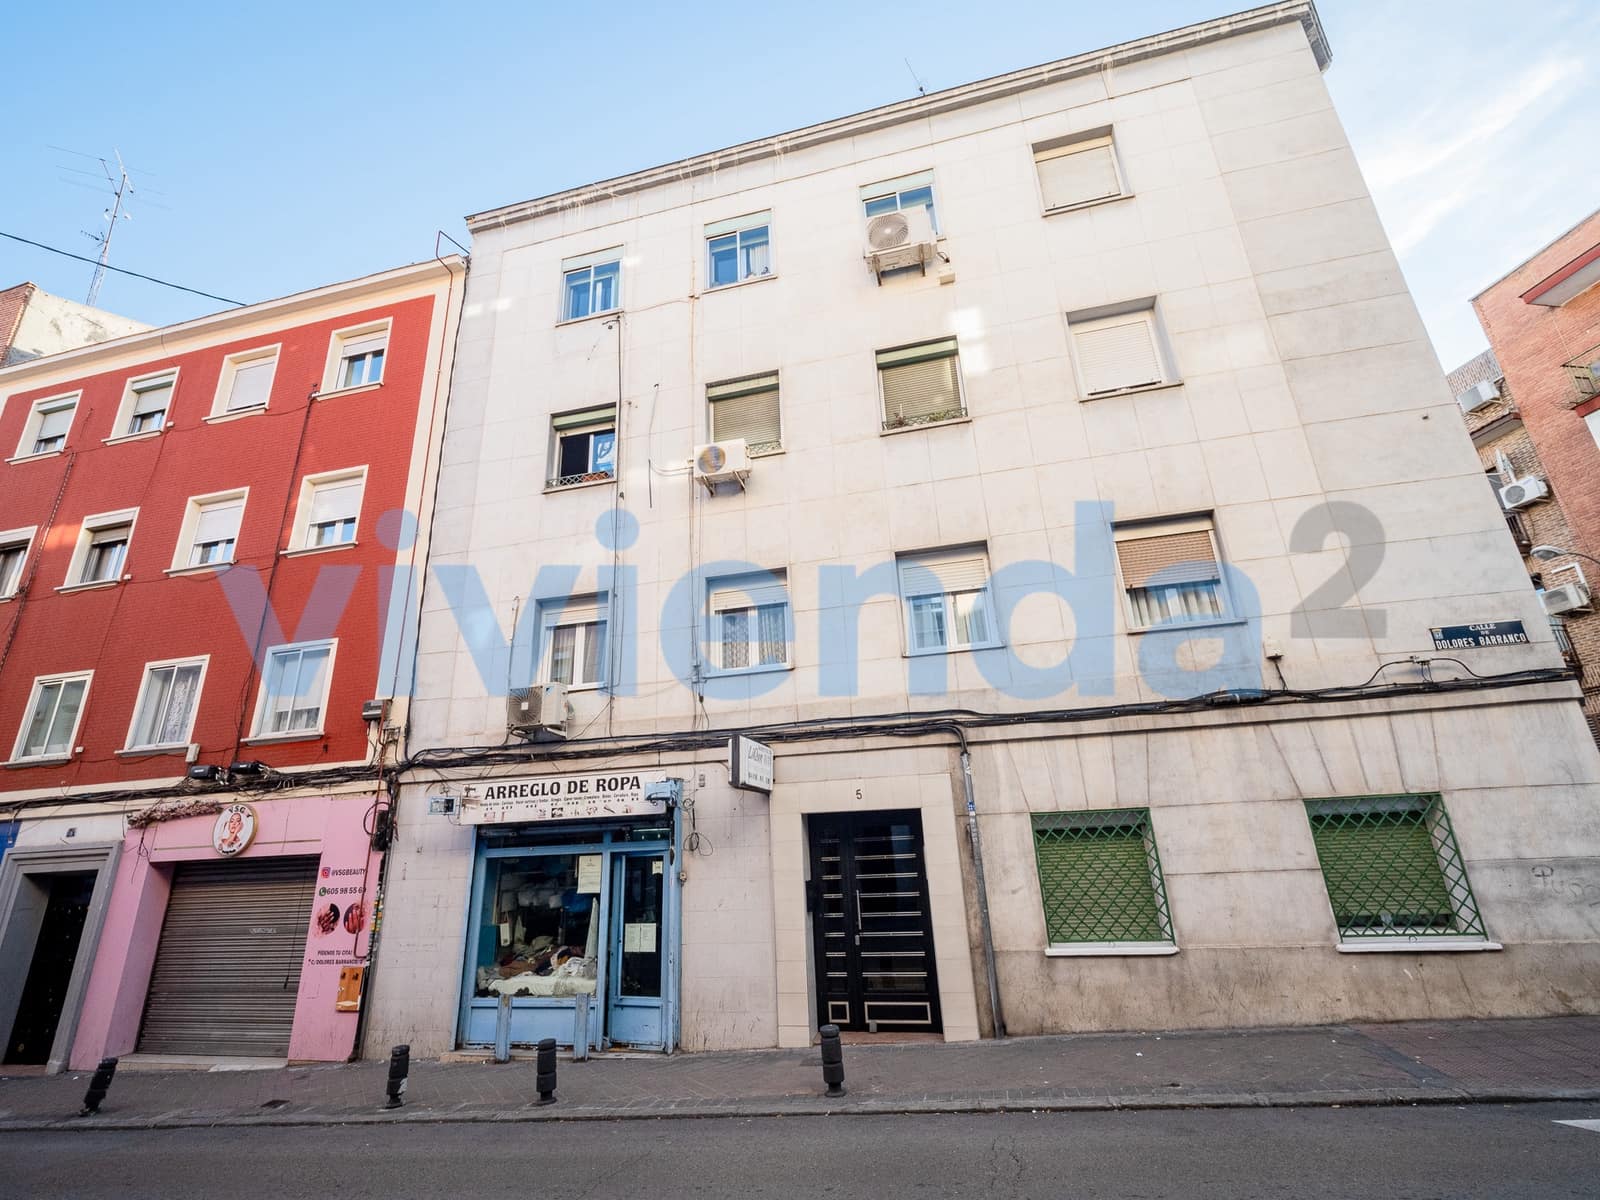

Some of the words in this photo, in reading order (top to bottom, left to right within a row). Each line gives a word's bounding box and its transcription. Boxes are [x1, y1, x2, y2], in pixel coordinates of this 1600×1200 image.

[1469, 623, 1496, 631] CALLE
[1436, 637, 1475, 649] DOLORES
[1478, 633, 1526, 646] BARRANCO
[484, 781, 561, 800] ARREGLO
[567, 780, 589, 794] DE
[596, 776, 641, 793] ROPA
[855, 788, 863, 800] 5
[326, 887, 339, 895] 605
[349, 886, 357, 894] 55
